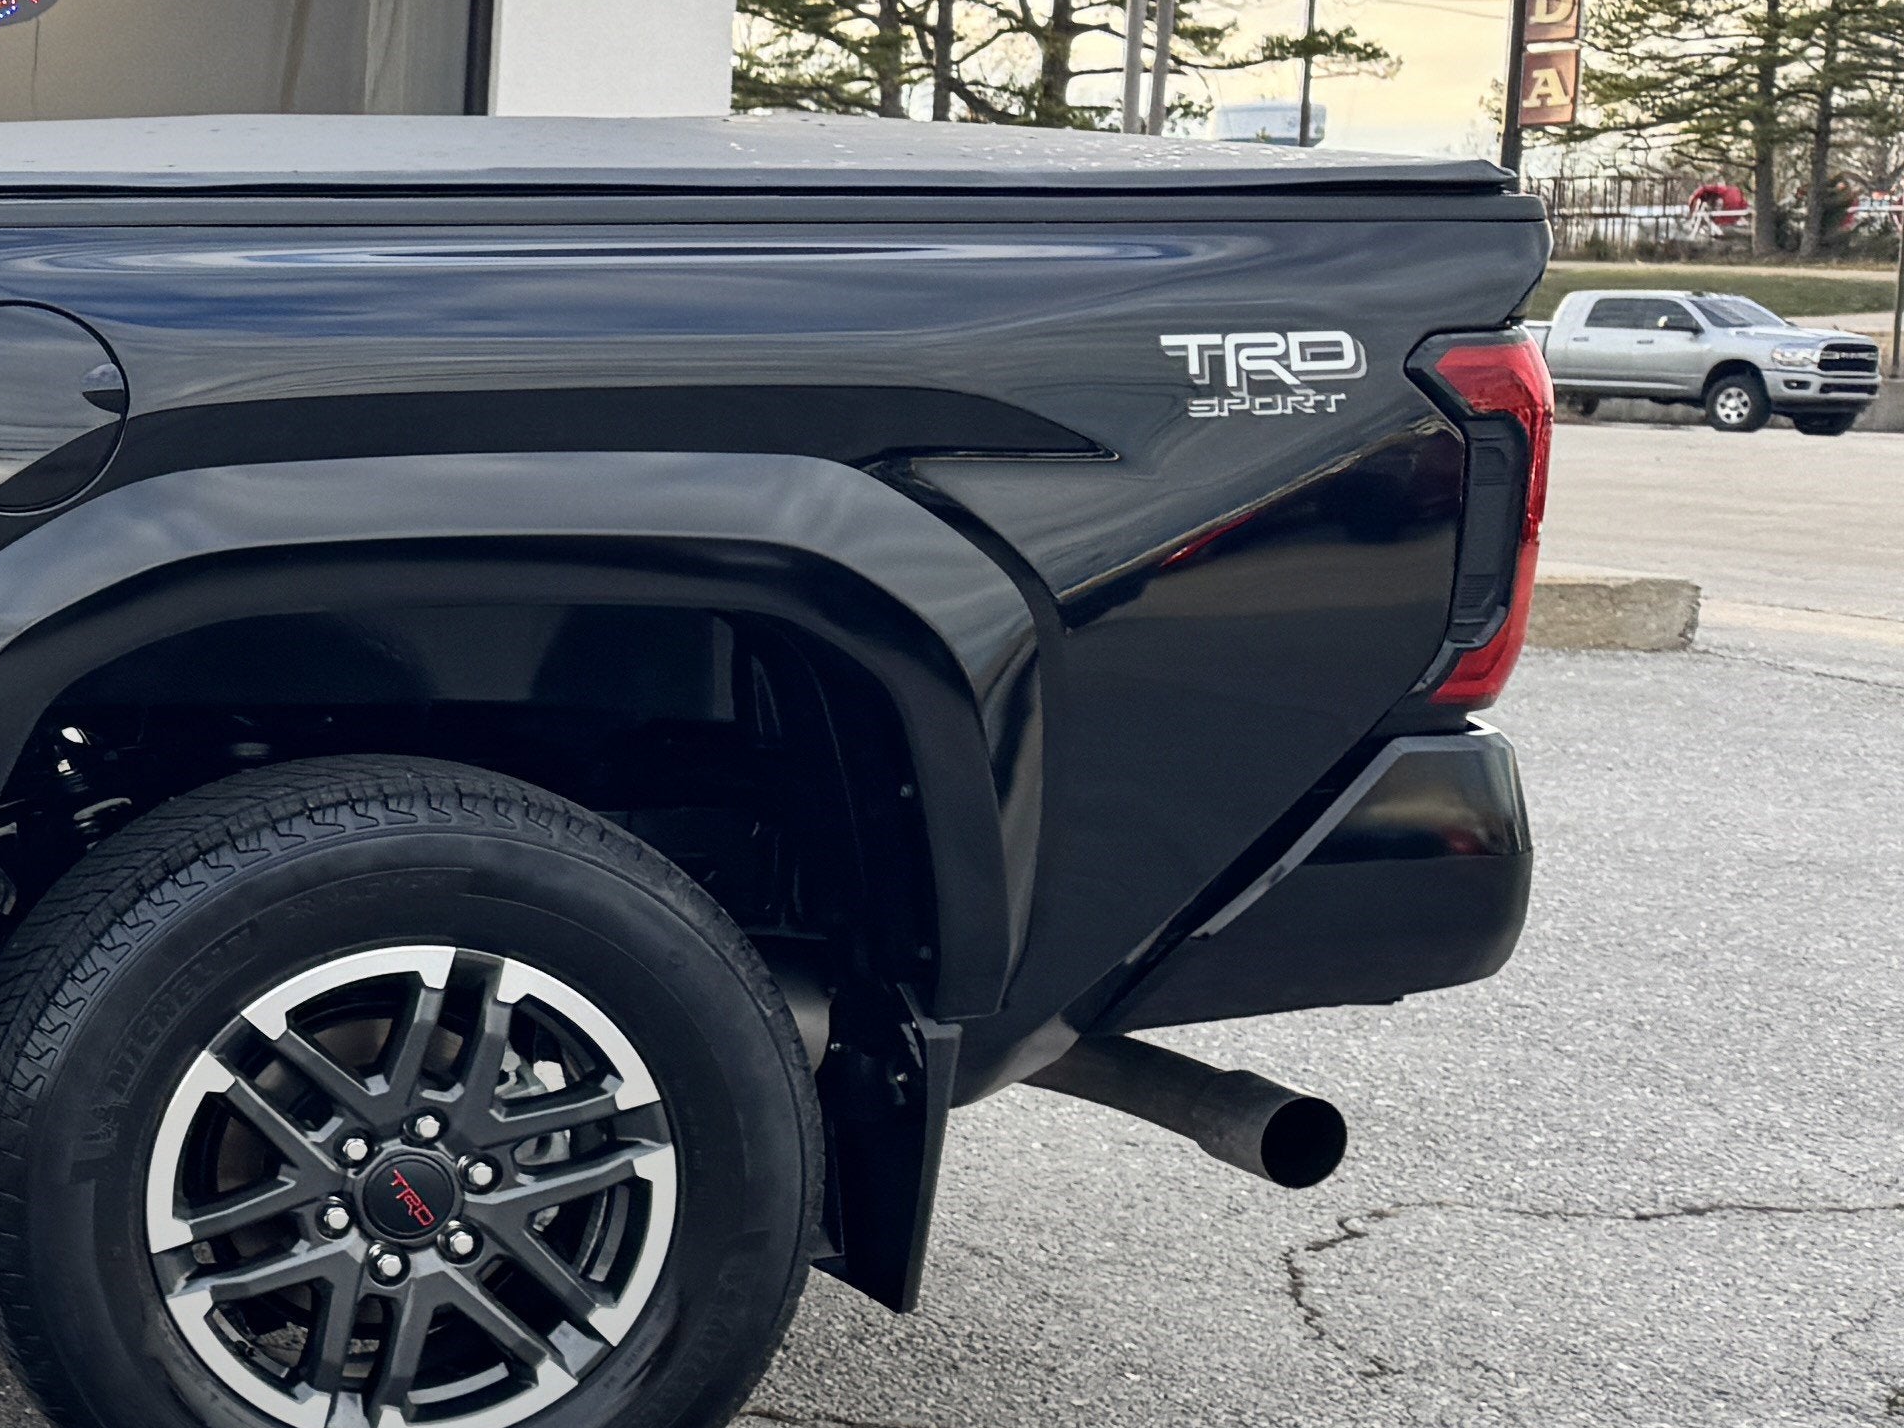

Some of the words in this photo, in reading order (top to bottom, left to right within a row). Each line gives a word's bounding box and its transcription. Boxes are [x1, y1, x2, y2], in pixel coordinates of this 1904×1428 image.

[1159, 330, 1367, 390] TRD
[1187, 392, 1347, 418] SPORT
[391, 1168, 436, 1227] TRD
